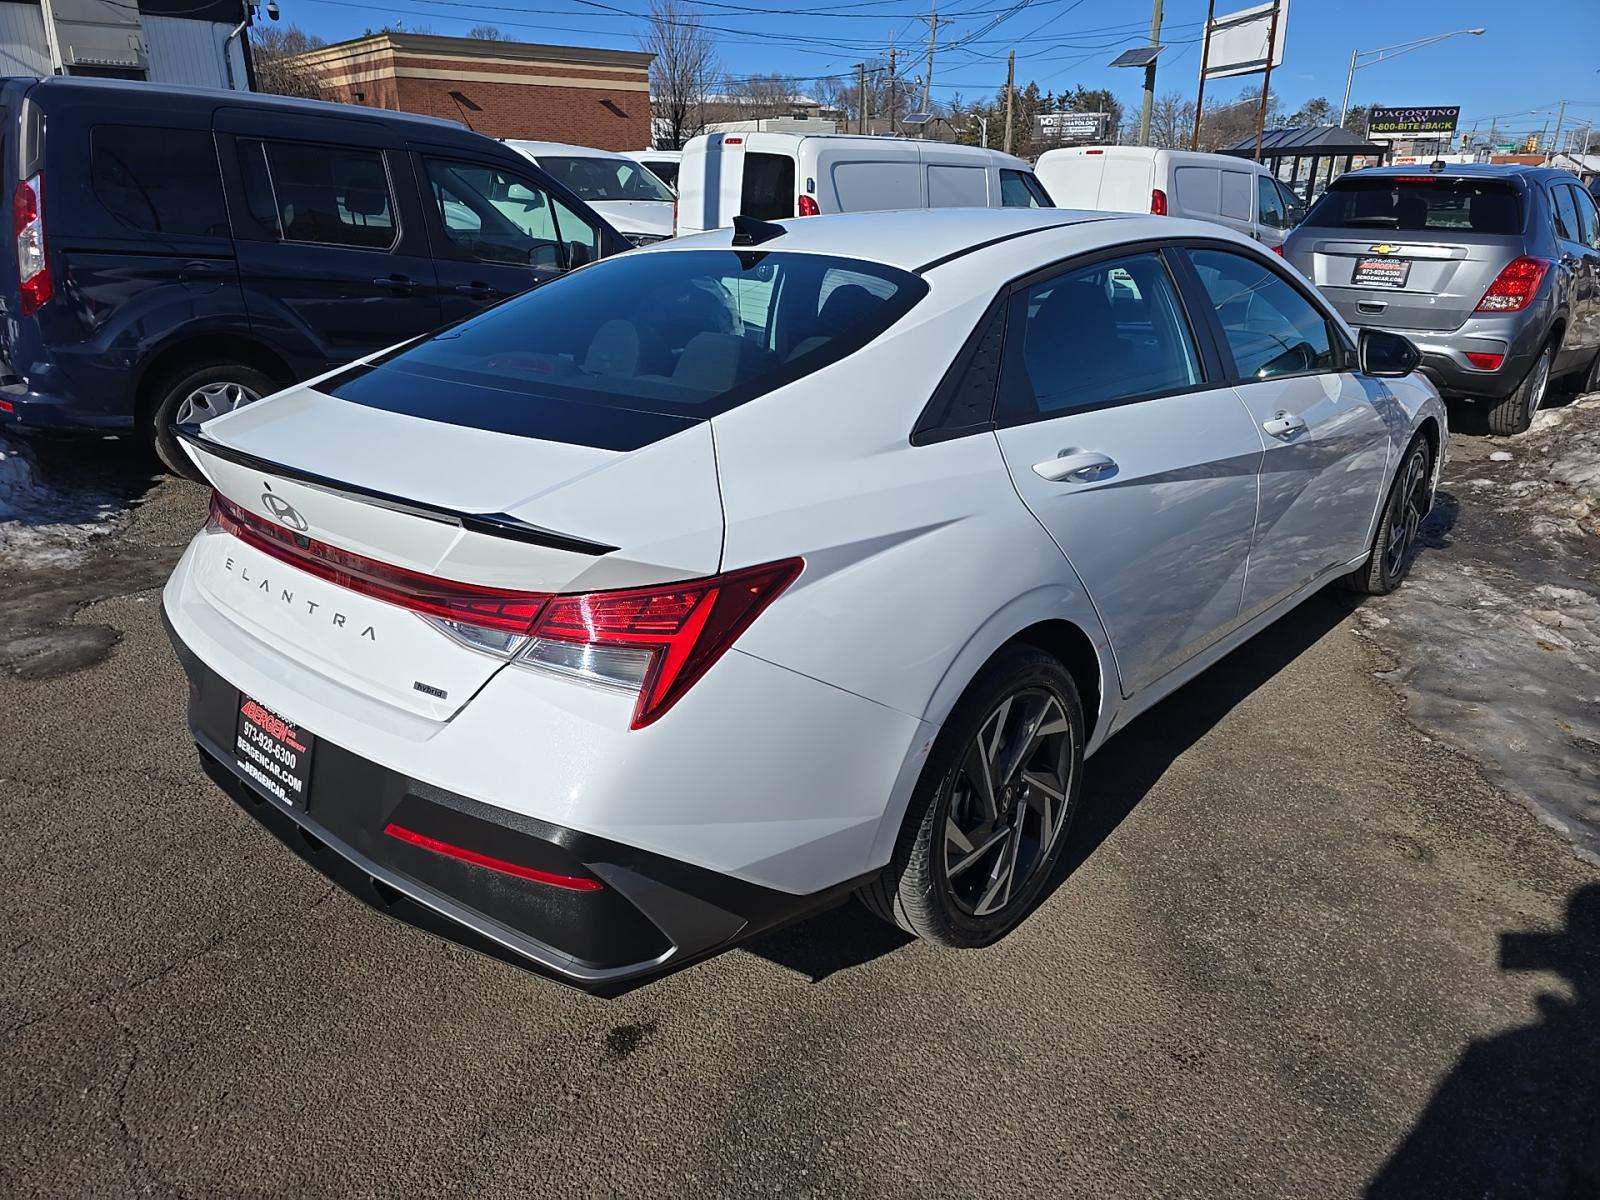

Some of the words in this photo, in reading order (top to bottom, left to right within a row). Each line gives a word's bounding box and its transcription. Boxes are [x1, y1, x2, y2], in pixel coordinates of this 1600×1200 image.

[1374, 108, 1457, 118] D'AGOSTINO
[1399, 115, 1429, 123] LAW
[225, 557, 376, 641] ELANTRA
[416, 682, 444, 699] hybrid
[243, 700, 289, 742] BERGEN
[237, 735, 302, 793] BERGENCAR.COM
[243, 721, 297, 769] 973-928-6300
